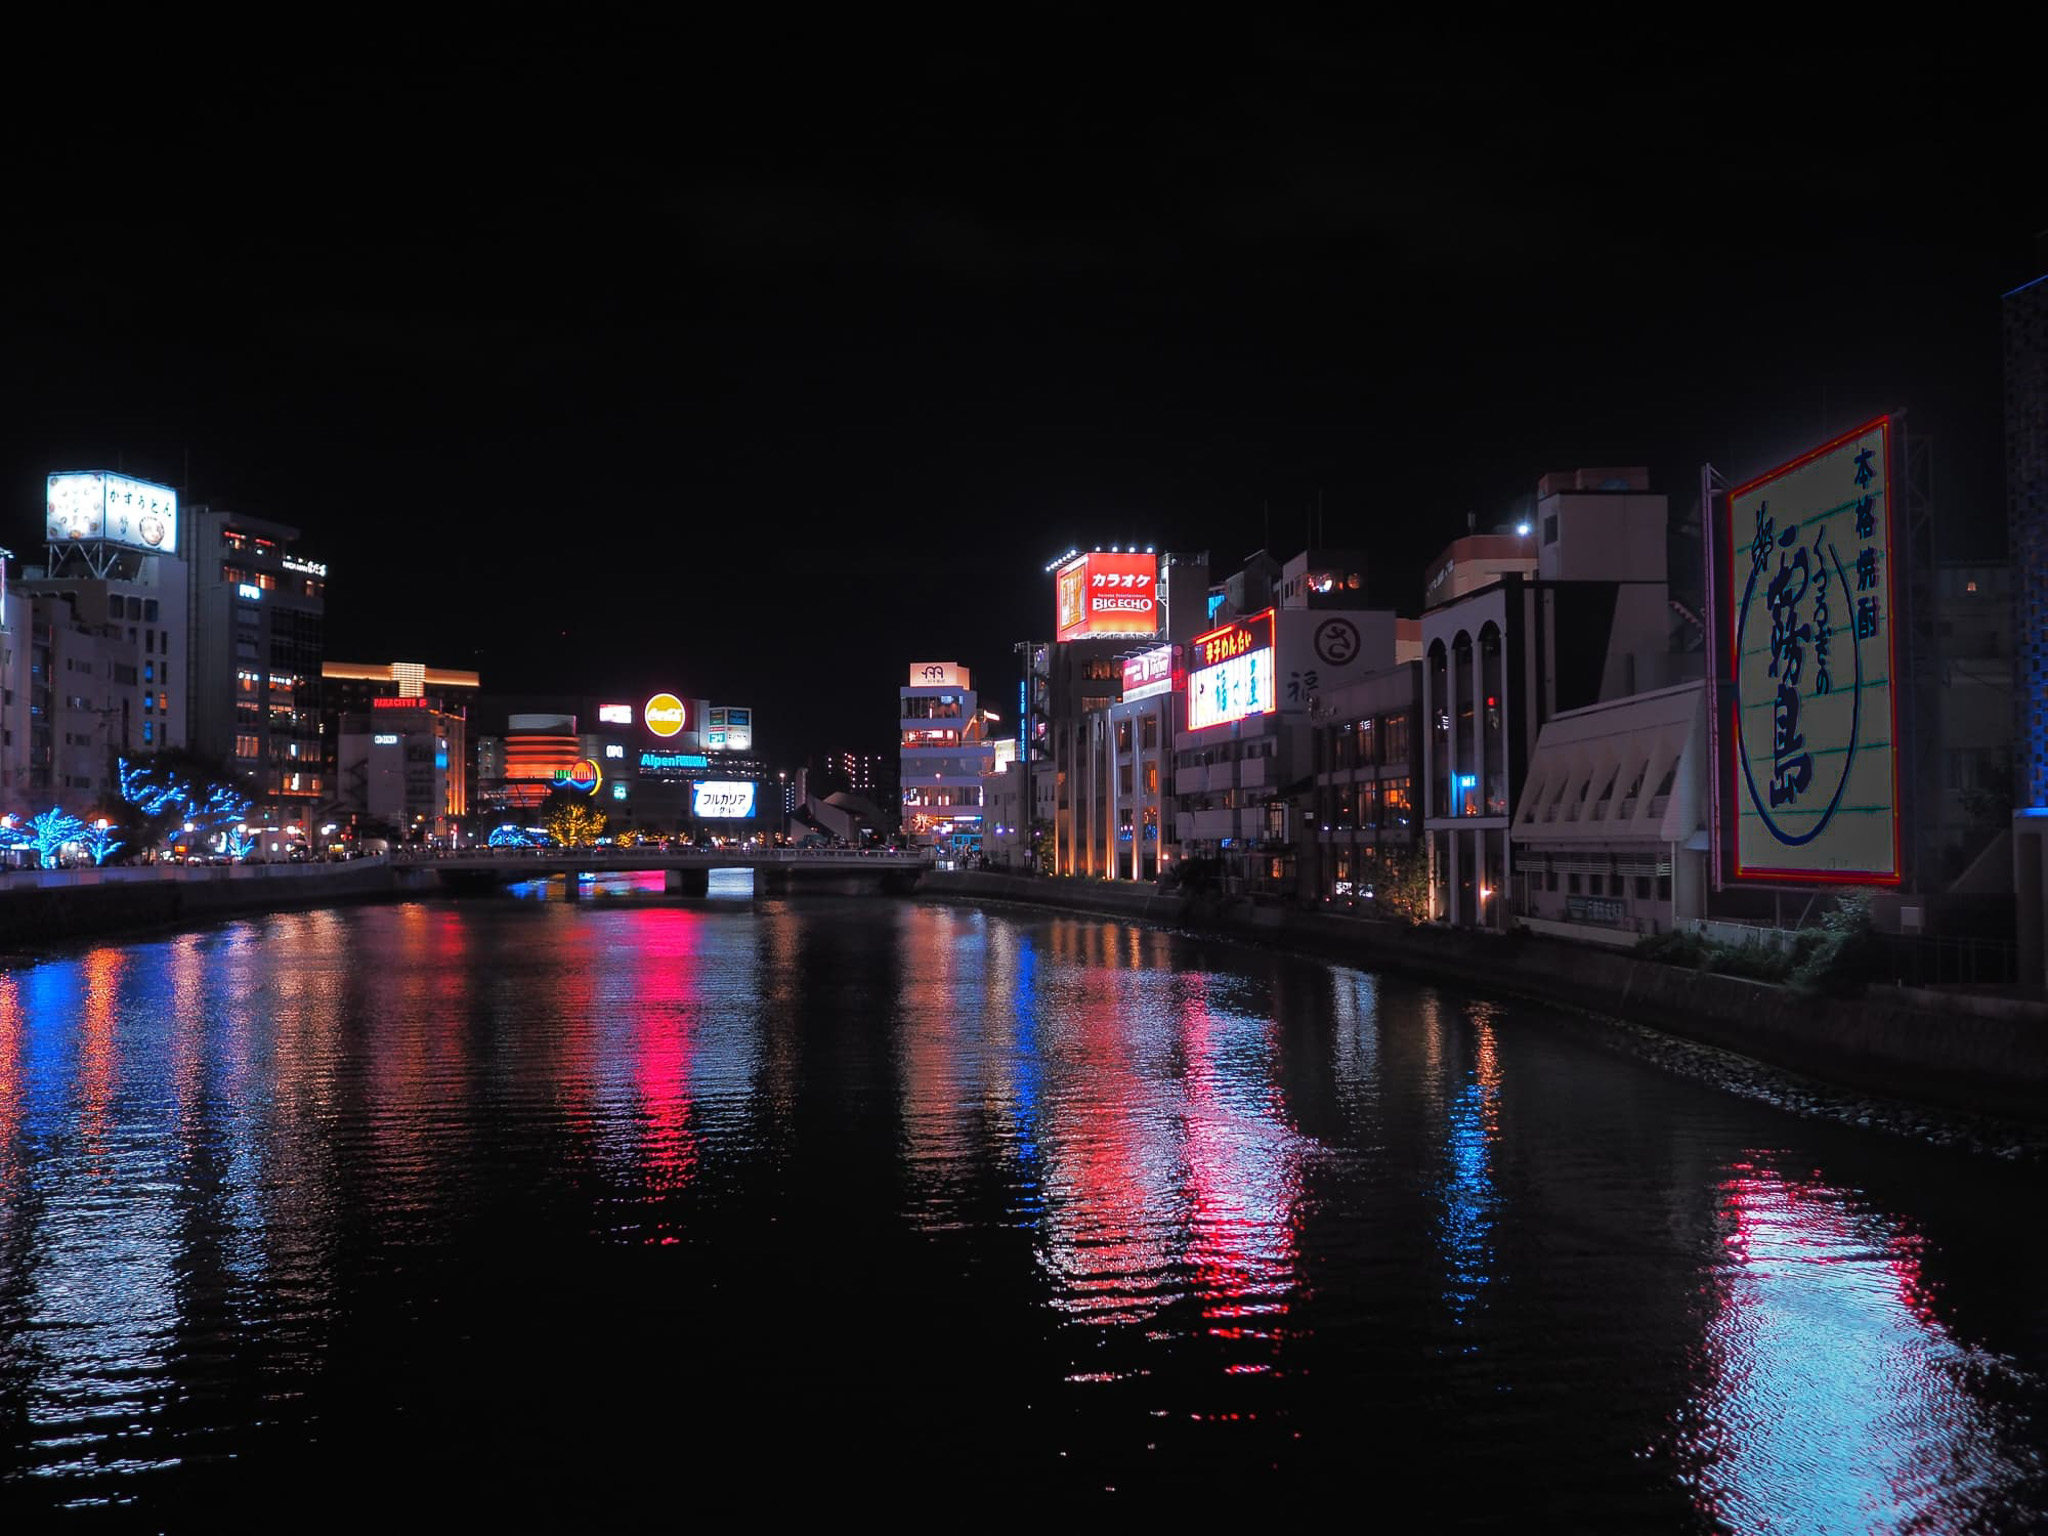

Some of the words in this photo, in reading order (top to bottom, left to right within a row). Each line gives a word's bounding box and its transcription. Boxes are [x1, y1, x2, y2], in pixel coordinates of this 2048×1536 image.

[1854, 447, 1877, 640] 本格焼酎
[1092, 573, 1152, 588] カラオケ
[1092, 598, 1117, 611] BIG
[1117, 598, 1152, 611] ECHO
[641, 754, 675, 769] Alpen
